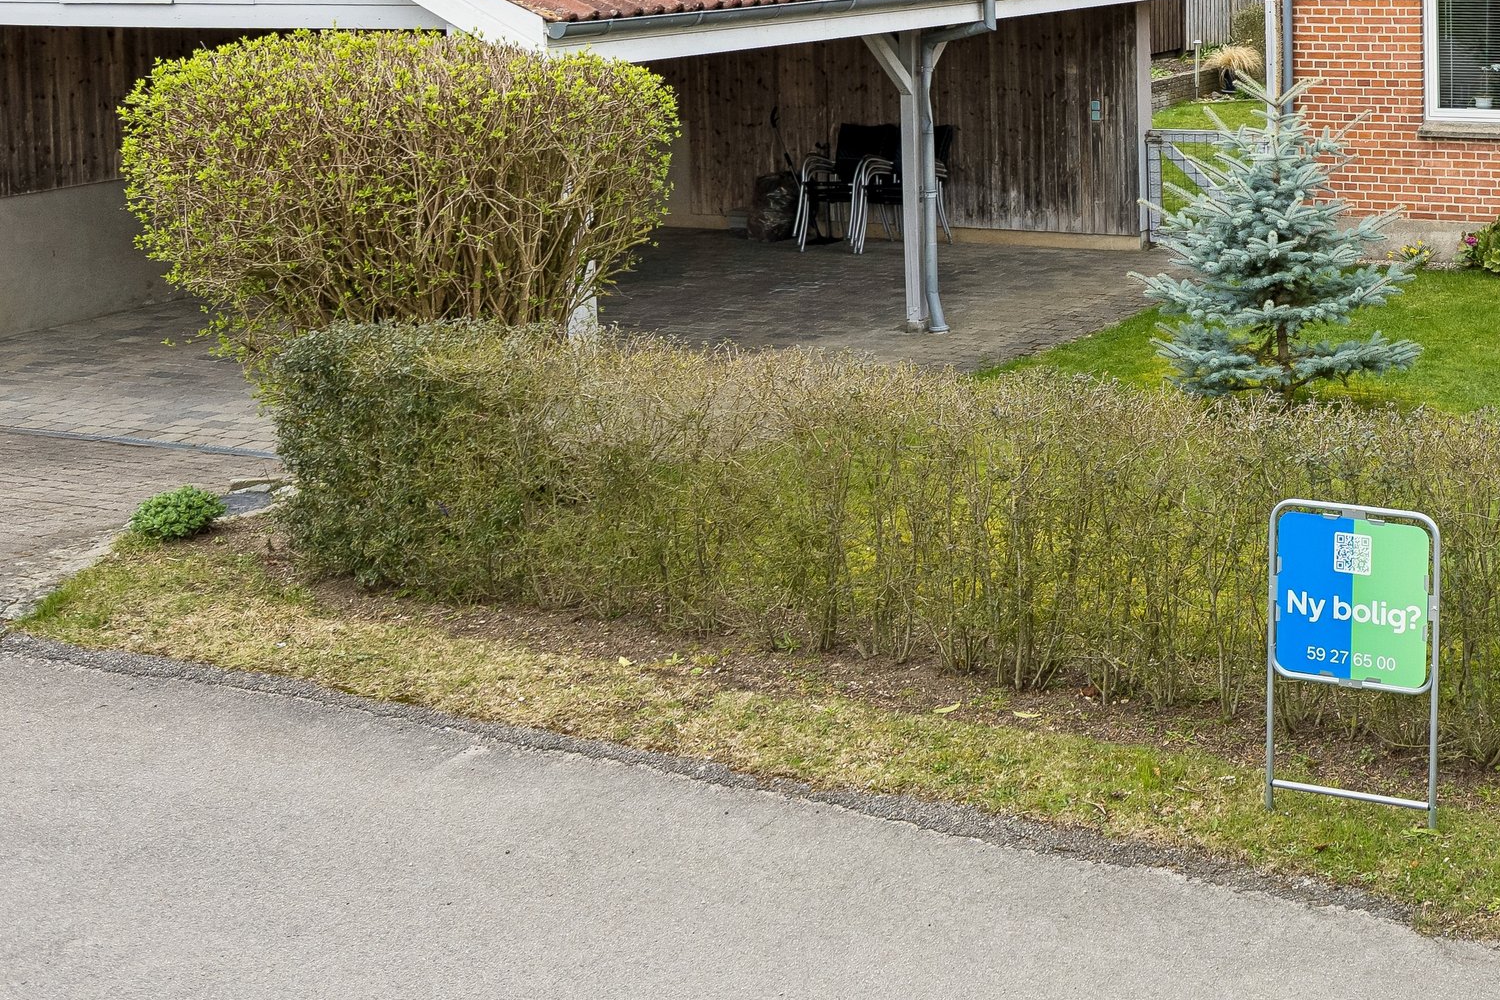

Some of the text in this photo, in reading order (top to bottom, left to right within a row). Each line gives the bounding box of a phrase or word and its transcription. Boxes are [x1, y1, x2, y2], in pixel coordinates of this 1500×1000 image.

[1287, 589, 1421, 634] Ny bolig?
[1306, 646, 1396, 671] 59 27 65 00
